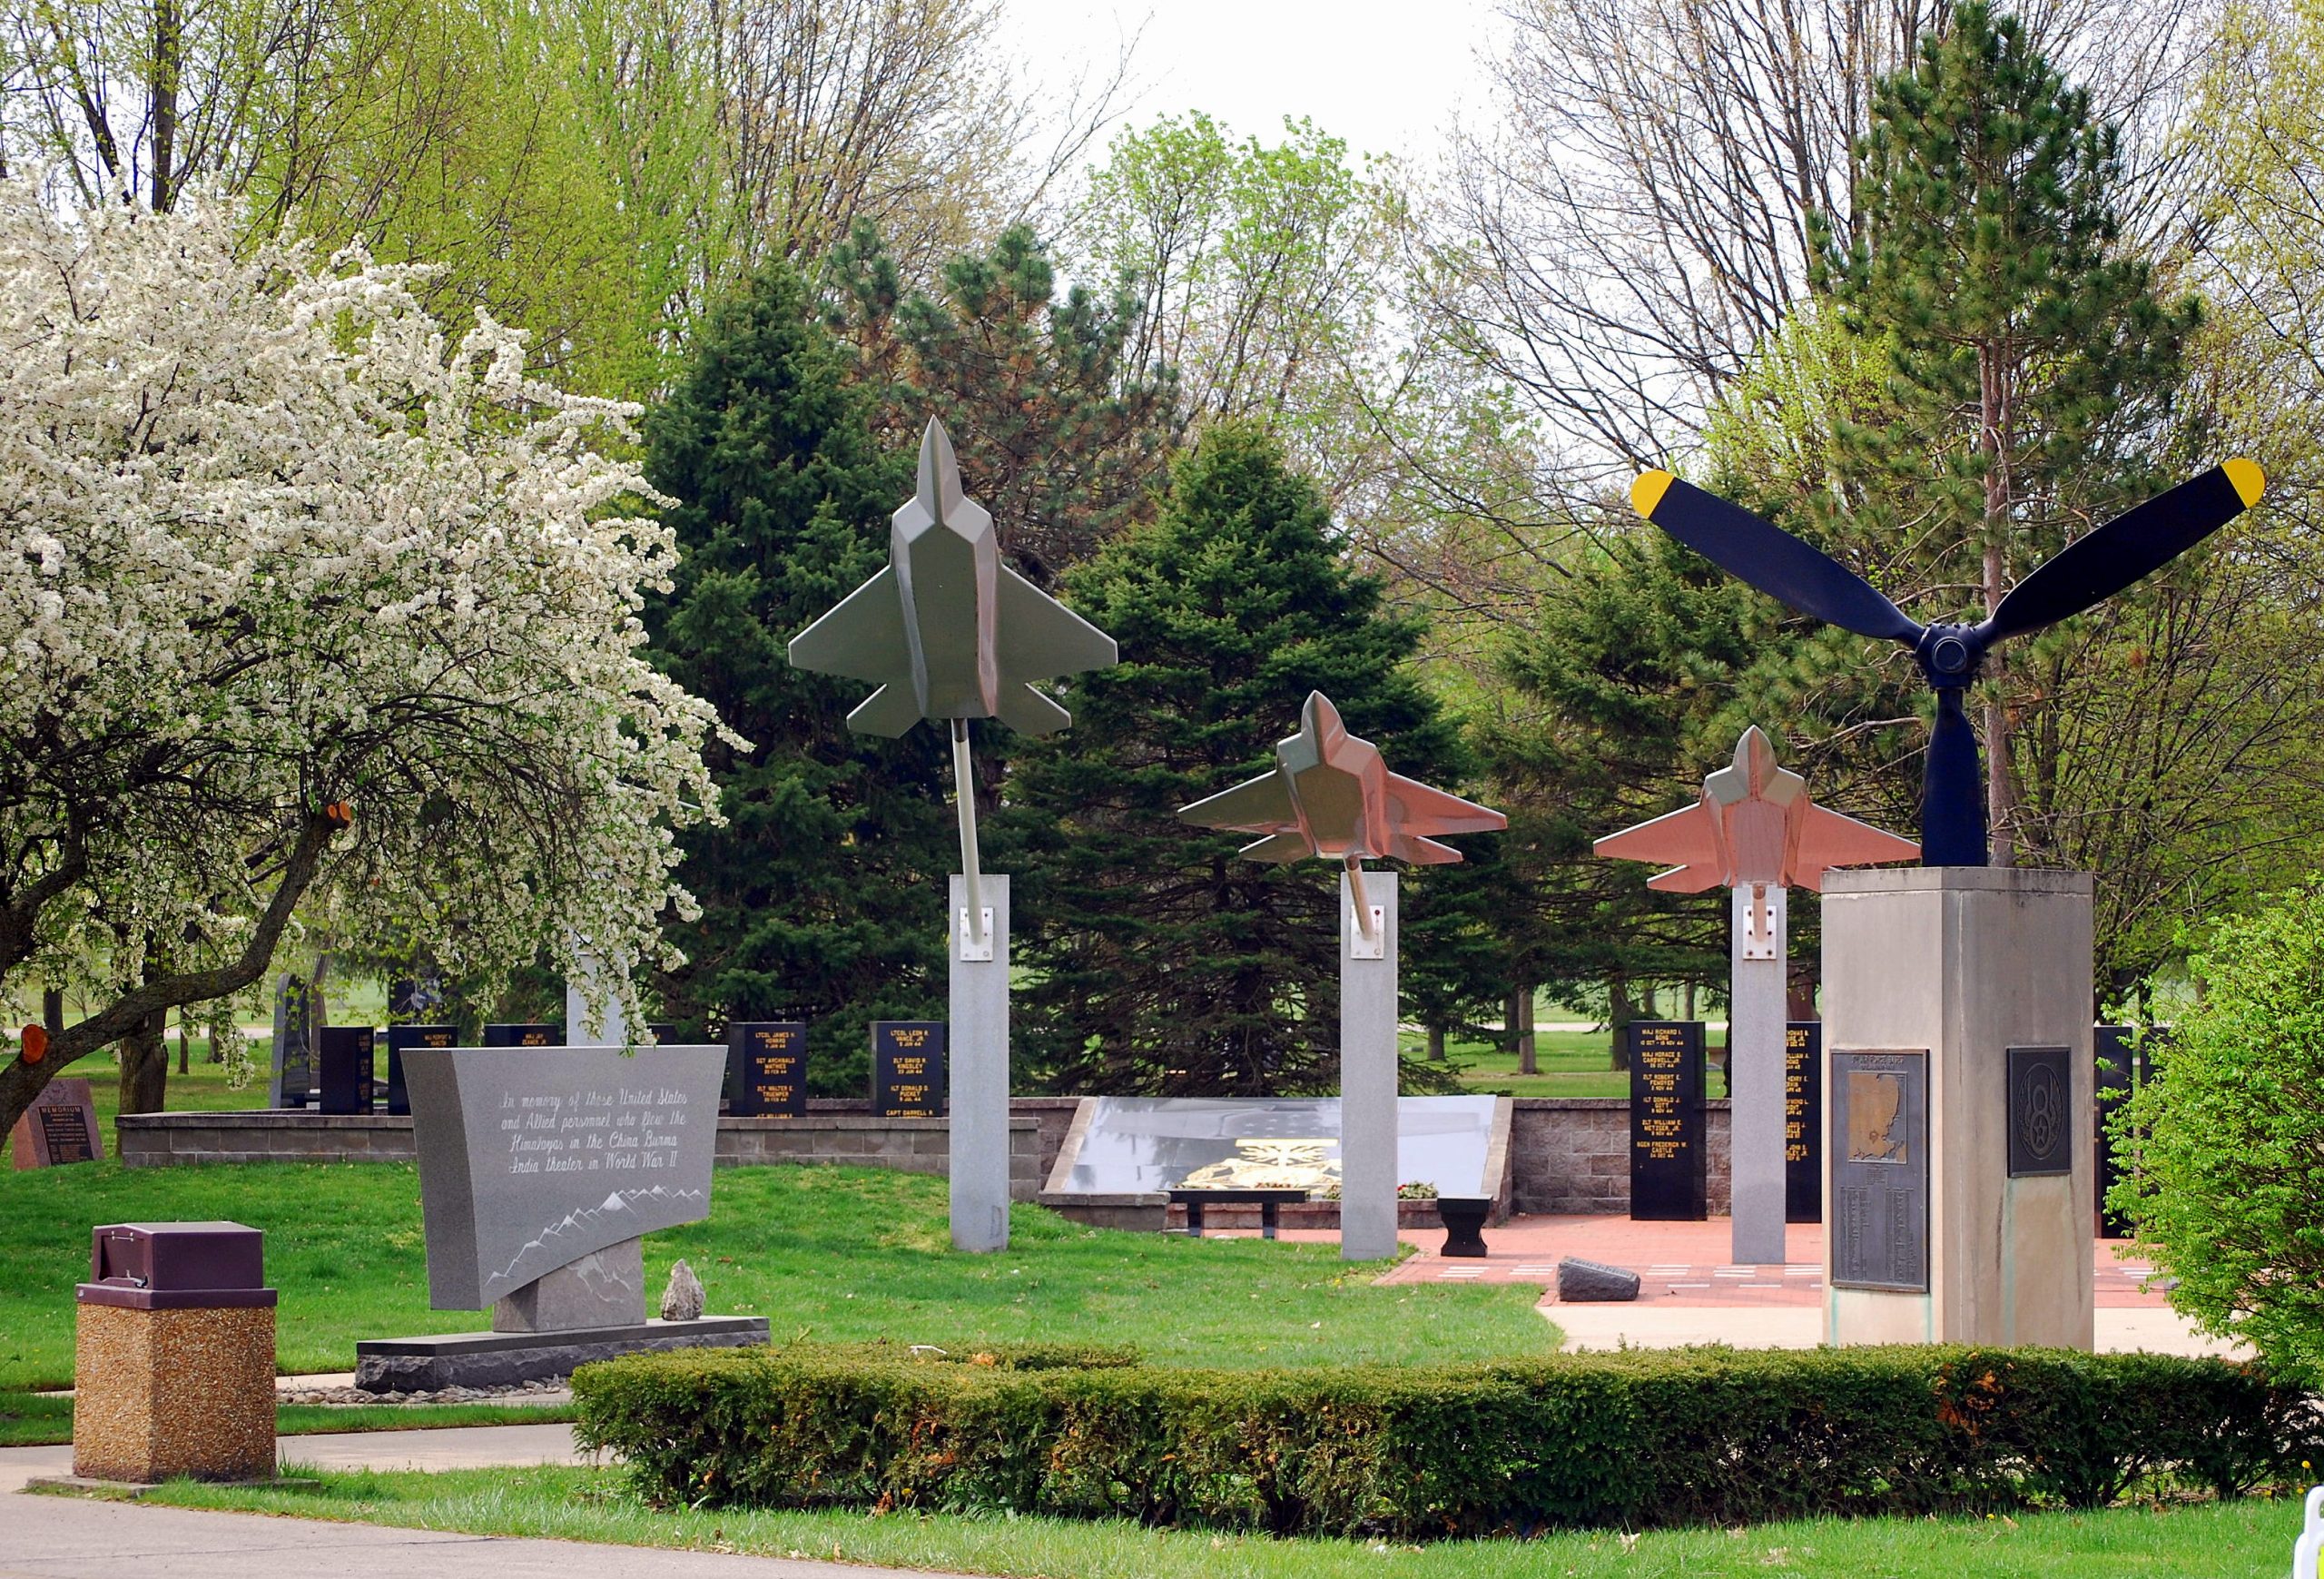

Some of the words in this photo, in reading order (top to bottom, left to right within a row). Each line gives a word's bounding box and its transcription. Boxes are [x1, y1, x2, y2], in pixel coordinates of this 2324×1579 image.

[500, 1091, 515, 1109] In
[522, 1095, 561, 1112] memory
[568, 1091, 580, 1111] of
[586, 1091, 614, 1107] those
[619, 1088, 653, 1106] United
[657, 1087, 688, 1105] States
[501, 1115, 520, 1130] and
[526, 1112, 556, 1129] Allied
[560, 1112, 611, 1133] personnel
[616, 1112, 636, 1127] who
[641, 1110, 662, 1131] flew
[670, 1110, 686, 1126] the
[509, 1134, 564, 1156] Himalayas
[569, 1136, 580, 1149] in
[586, 1133, 604, 1149] the
[608, 1131, 638, 1148] China
[644, 1130, 678, 1147] Burma
[508, 1156, 539, 1174] India
[545, 1155, 584, 1171] theater
[587, 1157, 599, 1169] in
[605, 1151, 636, 1169] World
[642, 1150, 665, 1169] War
[669, 1150, 678, 1167] II
